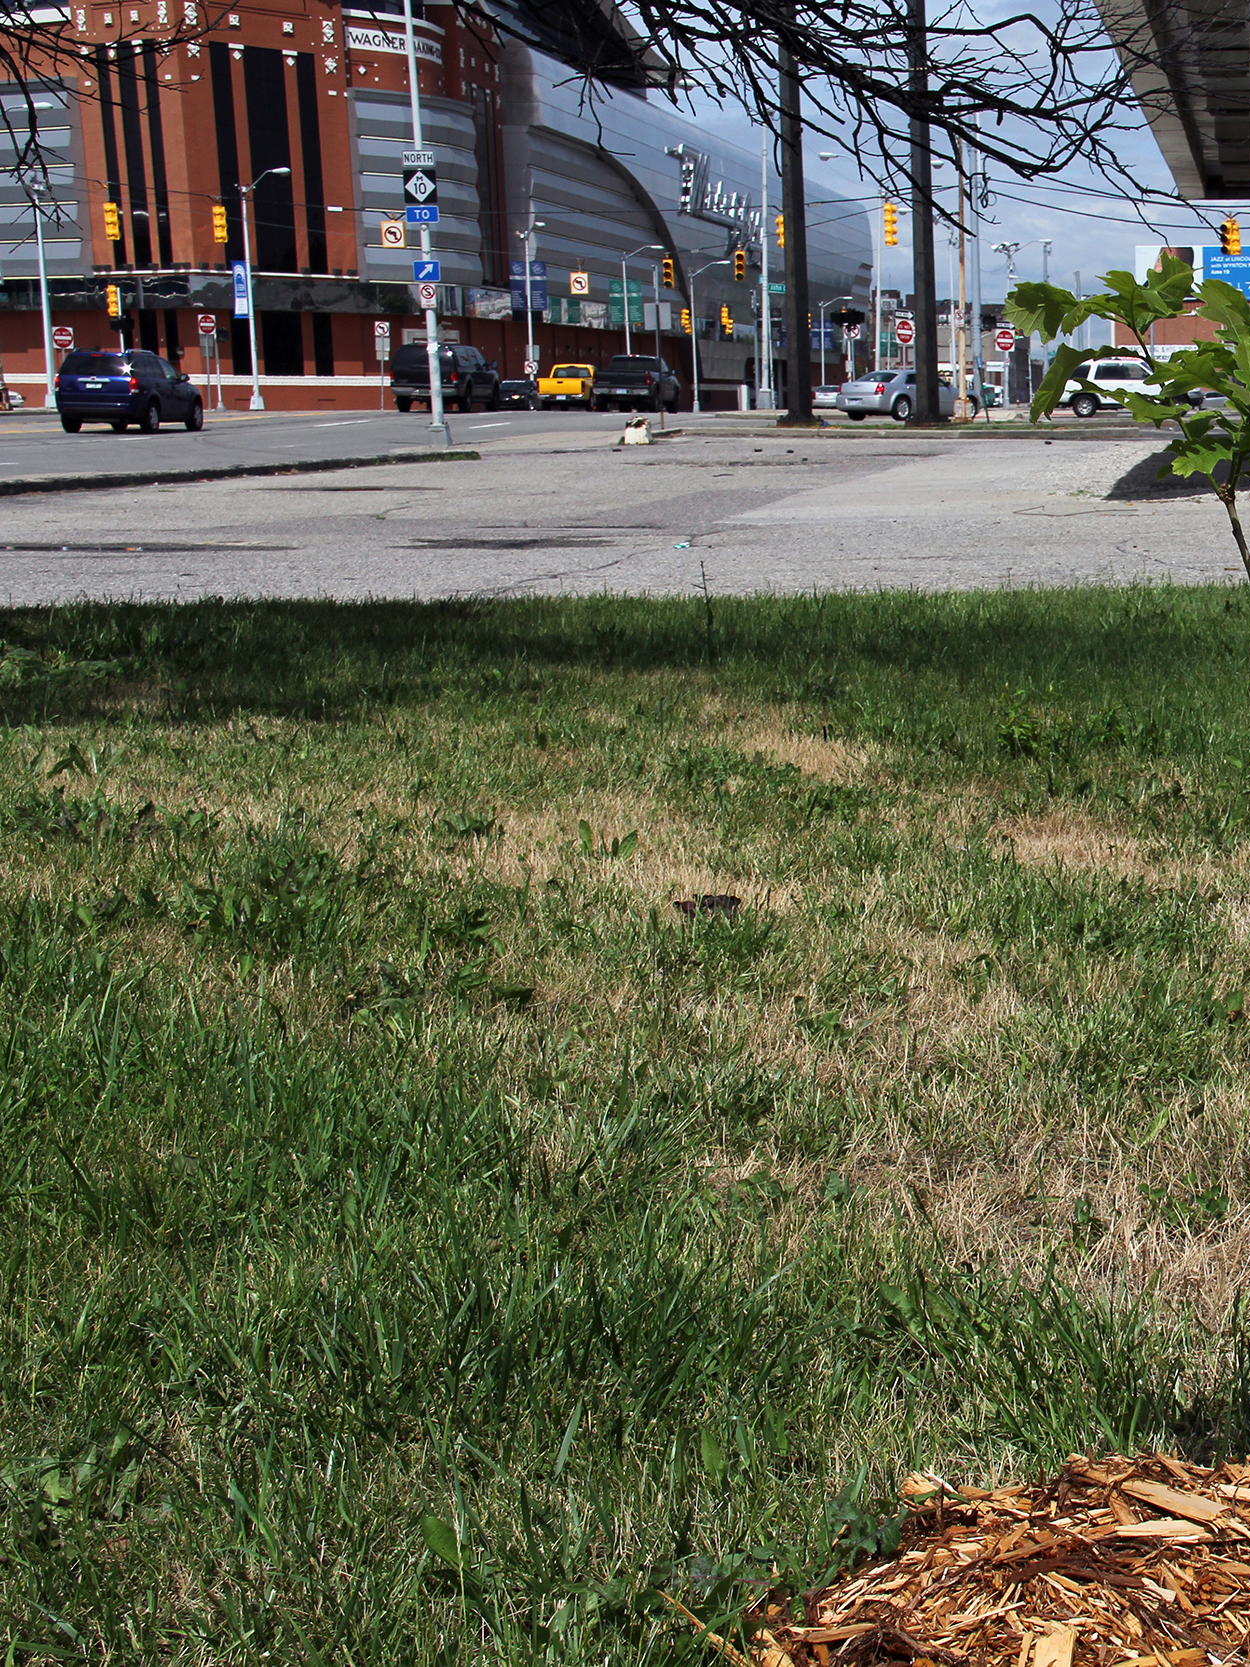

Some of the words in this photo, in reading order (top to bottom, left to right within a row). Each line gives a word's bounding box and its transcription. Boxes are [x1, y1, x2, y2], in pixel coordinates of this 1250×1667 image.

[349, 32, 406, 50] WAGNER
[404, 153, 433, 163] NORTH
[414, 182, 427, 194] 10
[413, 209, 430, 219] TO
